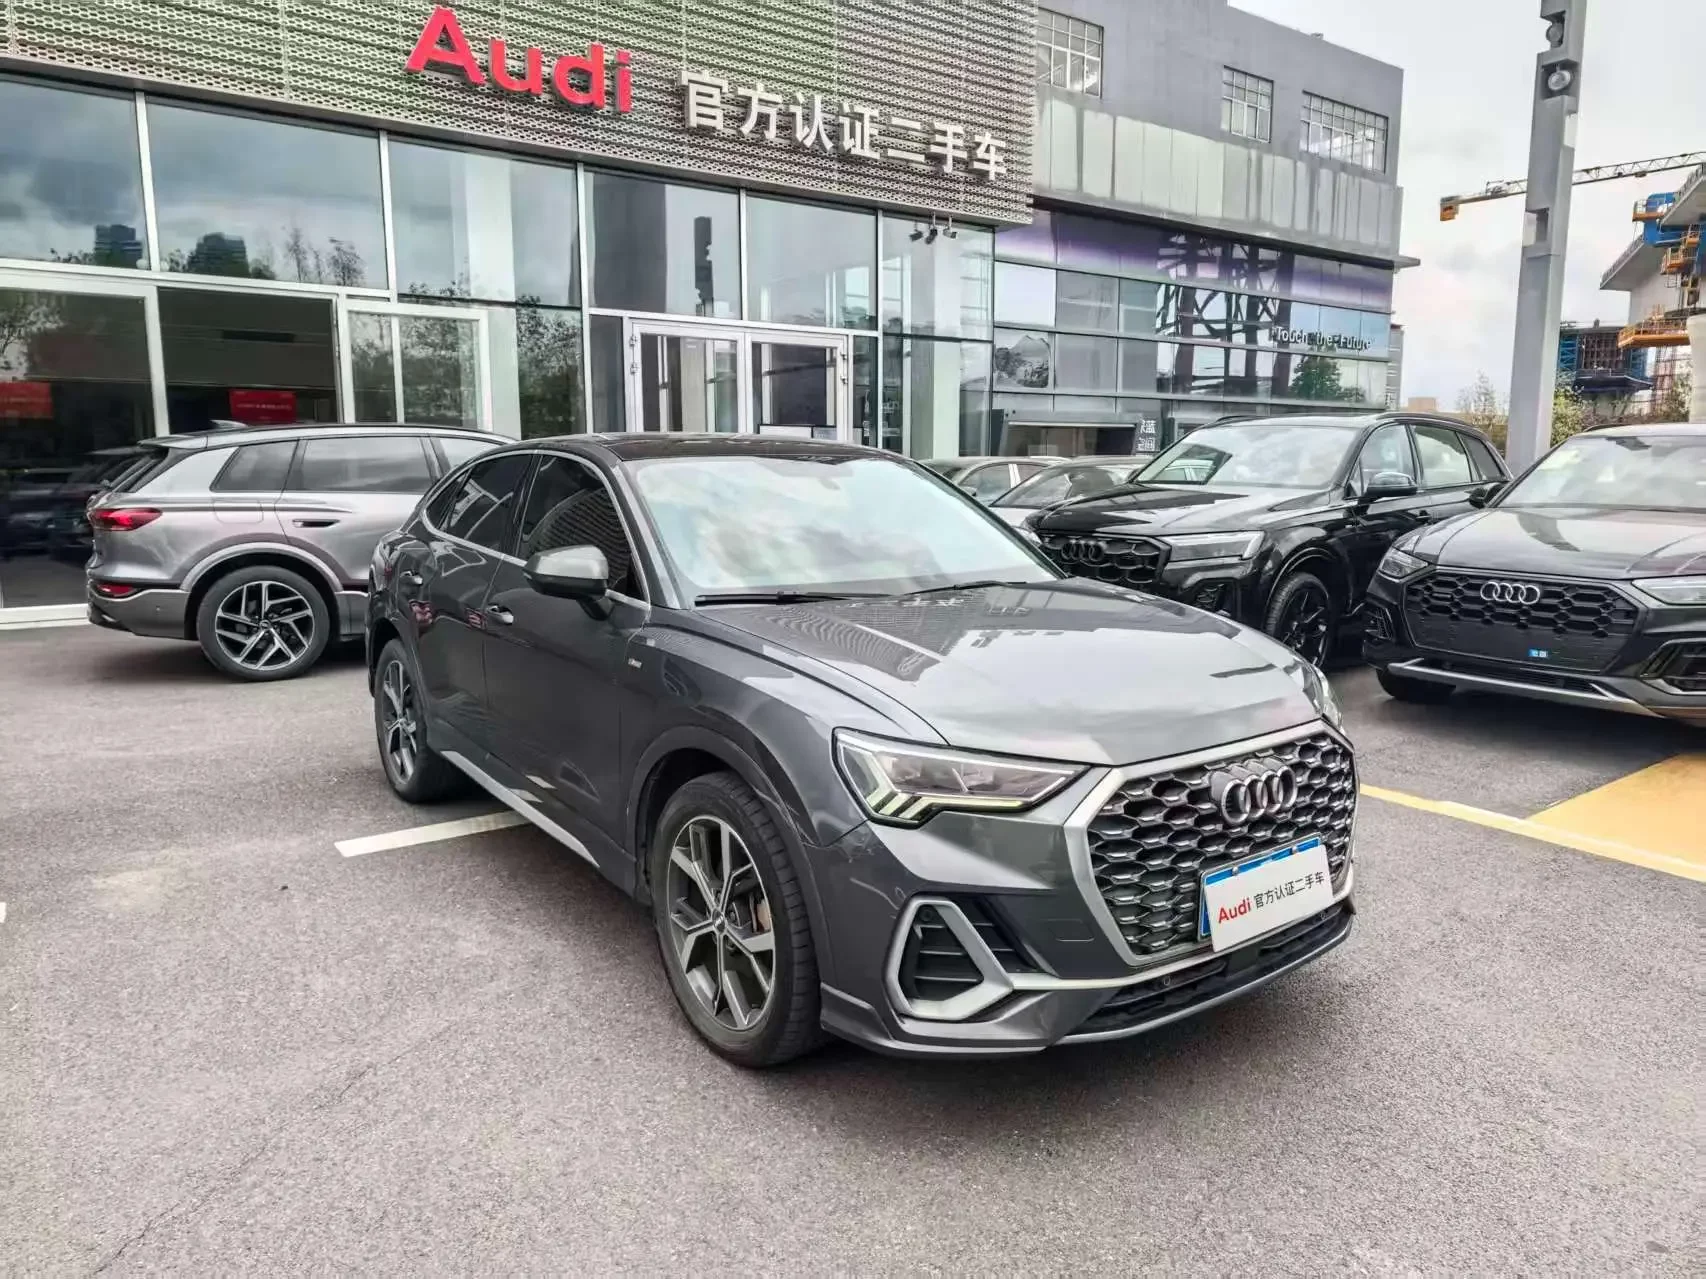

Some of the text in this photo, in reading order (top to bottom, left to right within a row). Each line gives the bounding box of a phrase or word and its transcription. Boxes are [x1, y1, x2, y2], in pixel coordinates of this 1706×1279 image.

[403, 5, 633, 113] Audi
[679, 69, 1007, 181] 官方认证二手车
[1316, 329, 1333, 346] the
[1253, 871, 1325, 909] 官方认证二手车
[1218, 896, 1252, 924] Audi
